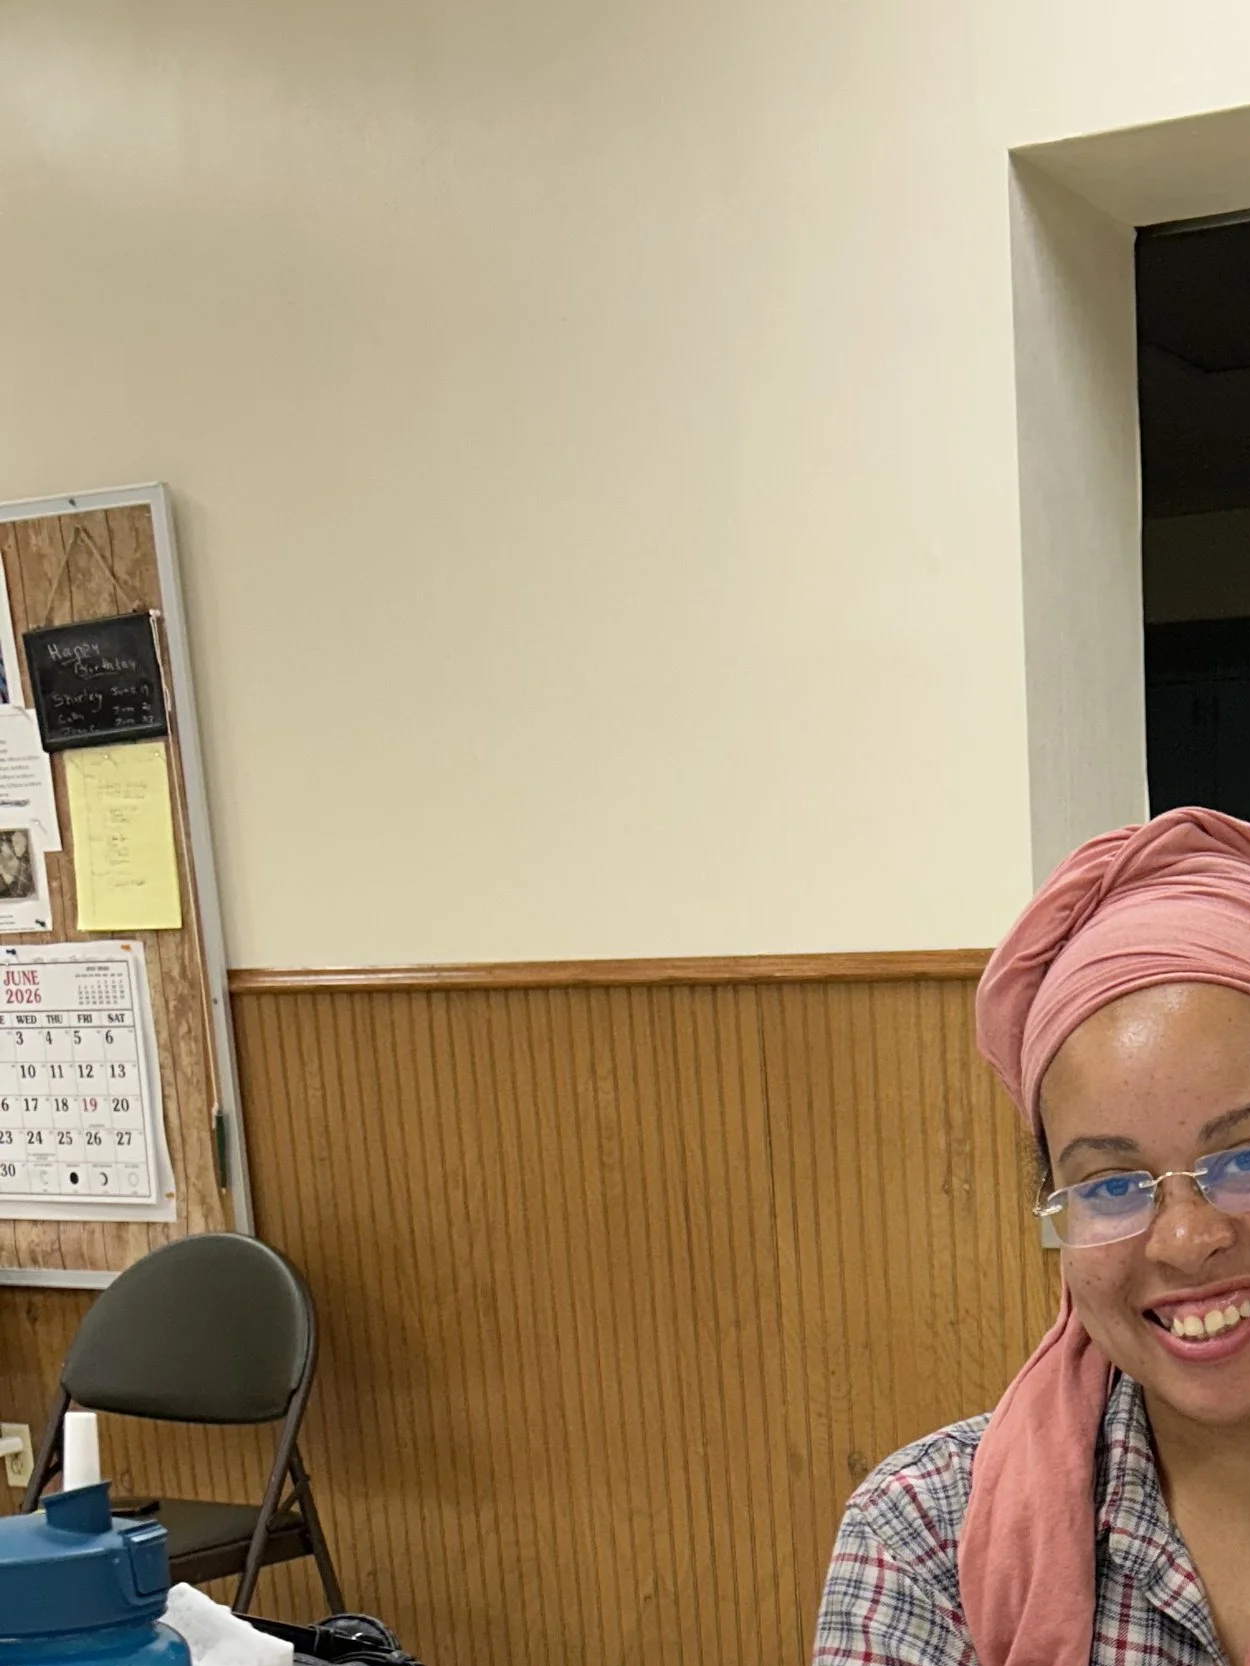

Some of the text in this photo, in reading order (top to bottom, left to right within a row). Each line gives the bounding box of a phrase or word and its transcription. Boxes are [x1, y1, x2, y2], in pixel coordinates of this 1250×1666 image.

[47, 643, 100, 663] Happy
[4, 970, 40, 986] JUNE
[5, 988, 42, 1004] 2026
[16, 1015, 37, 1025] WED
[46, 1014, 63, 1024] THU
[77, 1014, 93, 1023] FRI
[107, 1013, 125, 1023] SAT
[16, 1030, 114, 1045] 3 4 5 6
[20, 1064, 126, 1079] 10 11 12 13
[0, 1098, 129, 1112] 6 17 18 19 20
[27, 1131, 43, 1145] 24
[57, 1131, 73, 1145] 25
[86, 1132, 102, 1146] 26
[116, 1132, 132, 1145] 27
[0, 1163, 16, 1177] 30
